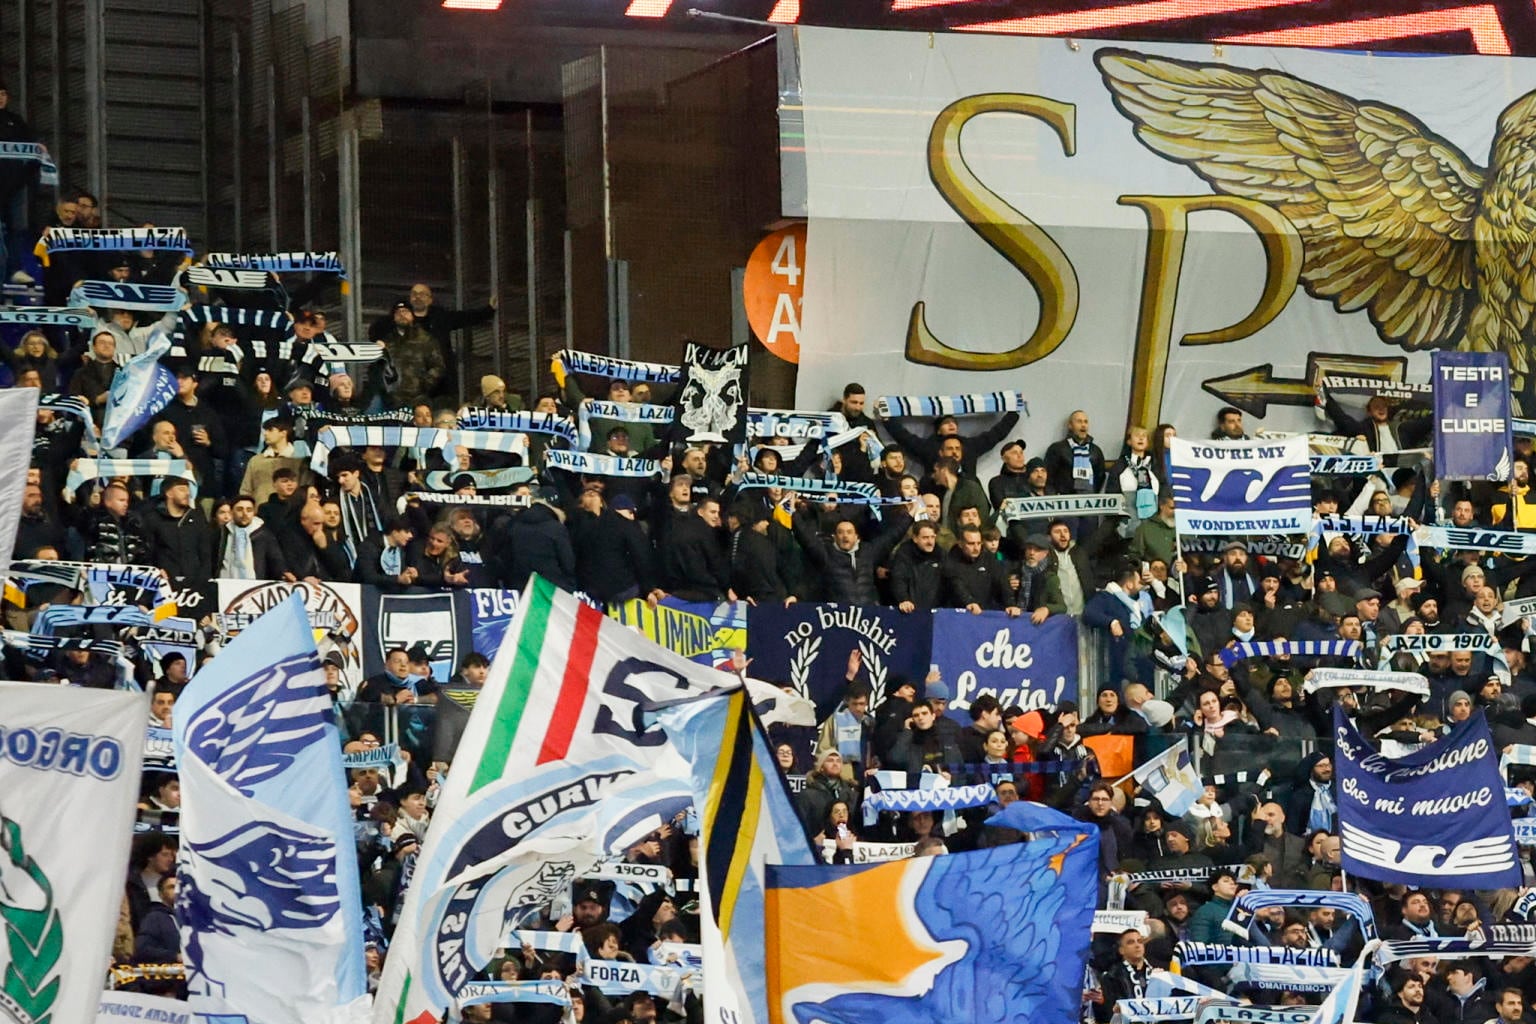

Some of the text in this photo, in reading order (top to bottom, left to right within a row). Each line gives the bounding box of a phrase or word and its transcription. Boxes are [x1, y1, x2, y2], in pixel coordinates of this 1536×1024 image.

[1439, 366, 1502, 382] TESTA
[1465, 393, 1478, 407] E
[1441, 418, 1505, 433] CUORE
[1191, 445, 1287, 460] YOU'RE MY
[1020, 497, 1118, 515] AVANTI LAZIO
[1187, 517, 1301, 531] WONDERWALL
[784, 605, 898, 654] no bullshit
[976, 628, 1033, 669] che
[1452, 635, 1493, 649] 1900
[1336, 725, 1356, 761] Sei
[1359, 754, 1387, 777] la
[1342, 776, 1493, 817] che mi muove
[615, 863, 657, 878] 1900
[590, 965, 641, 984] FORZA
[1217, 1007, 1311, 1023] LAZIO
